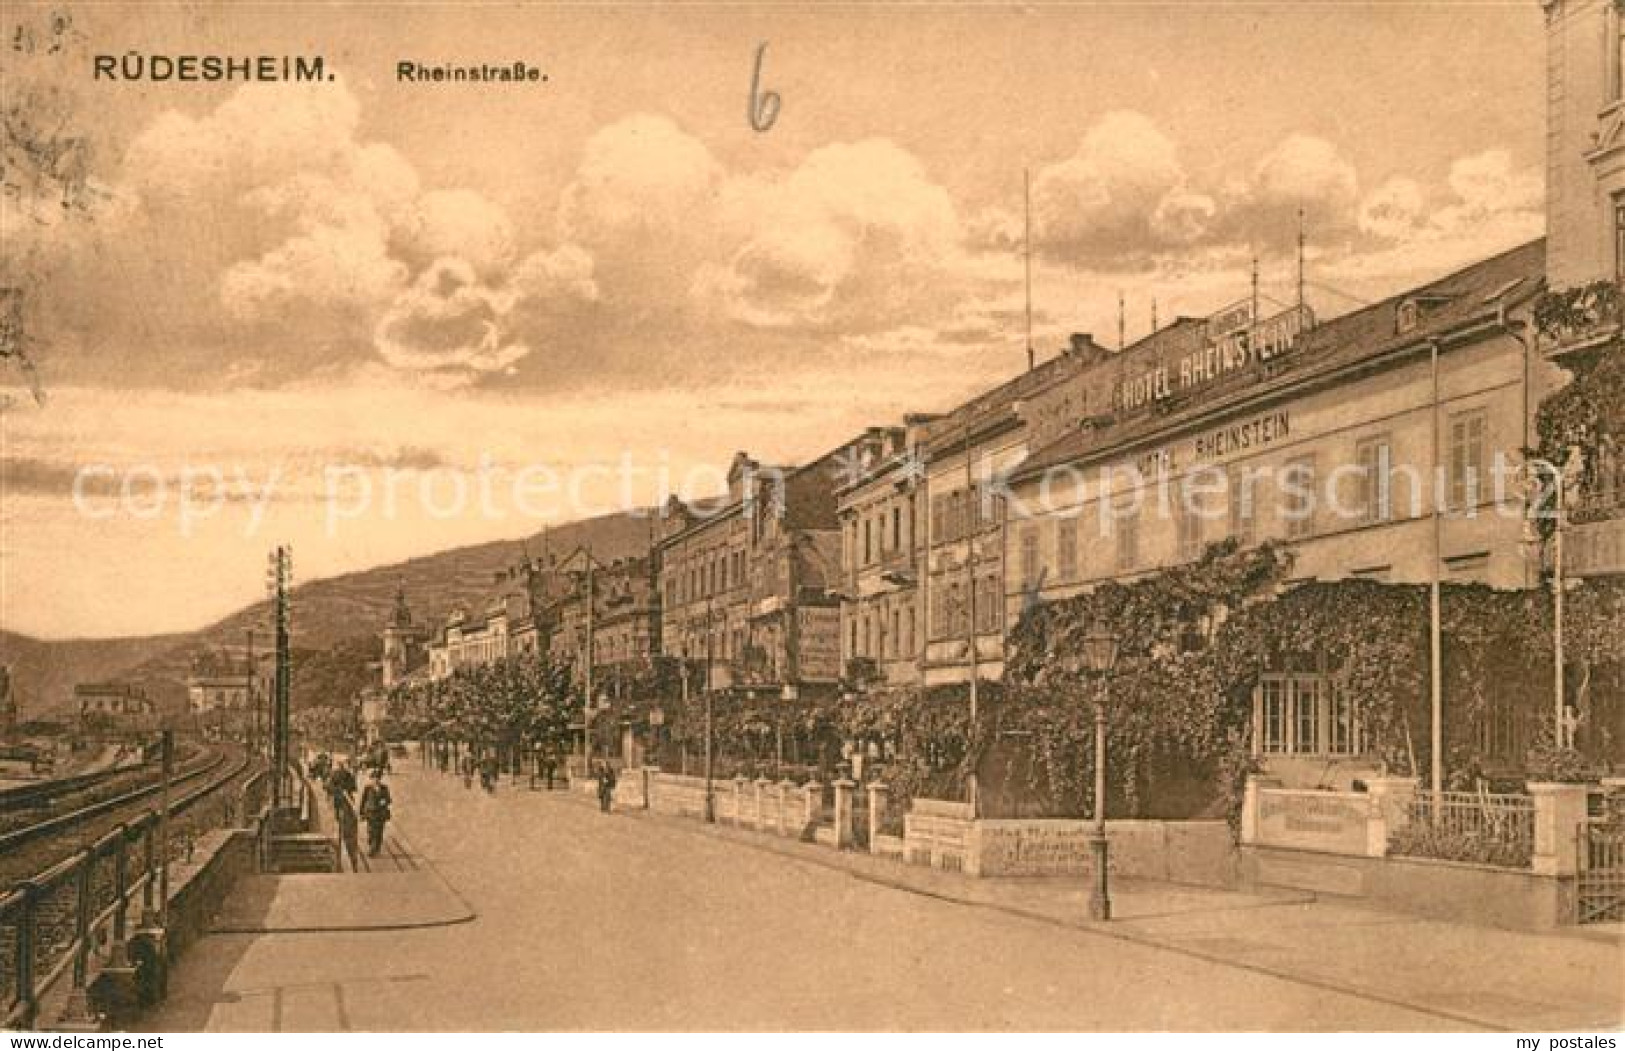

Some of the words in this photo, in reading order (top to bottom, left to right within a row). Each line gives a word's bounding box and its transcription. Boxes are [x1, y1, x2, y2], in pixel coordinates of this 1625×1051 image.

[747, 41, 781, 133] 6
[1122, 364, 1172, 409] HOTEL
[1195, 409, 1289, 461] RHEINSTEIN
